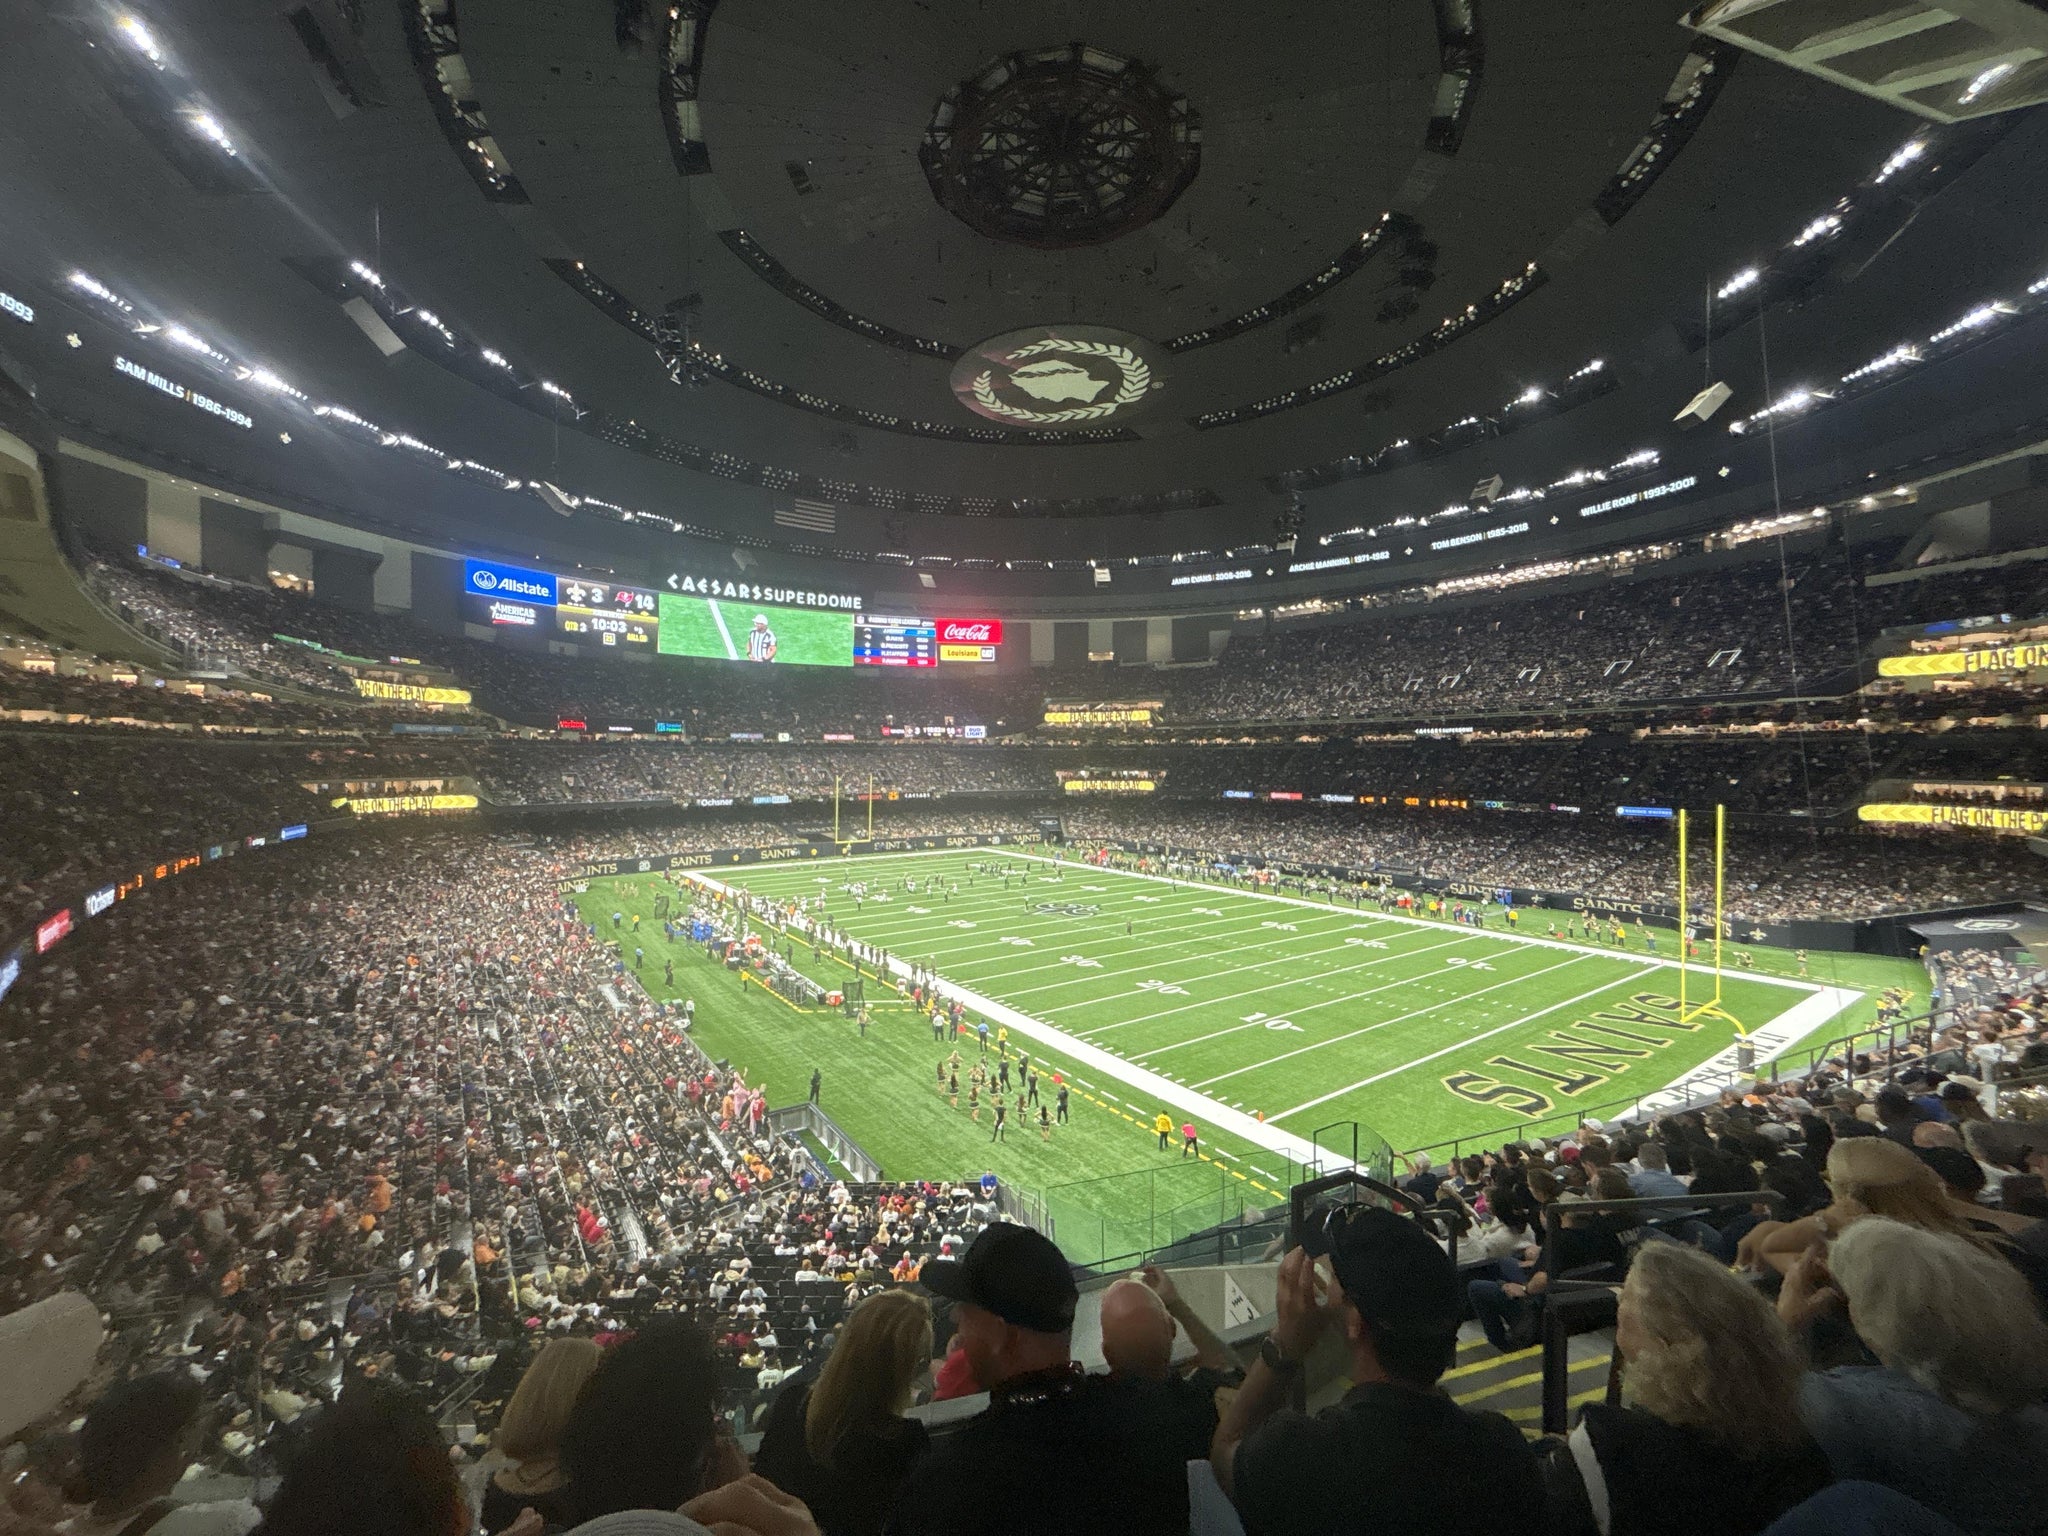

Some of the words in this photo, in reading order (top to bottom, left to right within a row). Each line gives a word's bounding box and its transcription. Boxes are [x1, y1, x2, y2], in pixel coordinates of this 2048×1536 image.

[115, 356, 146, 381] SAM
[147, 371, 185, 399] MILLS
[192, 392, 252, 428] 1986-1994
[1580, 500, 1611, 516] WILLIE
[1612, 493, 1638, 509] ROAF
[1643, 476, 1696, 499] 1993-2001
[1431, 538, 1450, 550] TOM
[1450, 532, 1482, 547] BENSON
[1487, 522, 1529, 539] 1985-2018
[1316, 557, 1350, 569] MANNING
[498, 577, 551, 598] Allstate
[667, 573, 762, 600] CAESARS
[764, 587, 862, 610] SUPERDOME
[592, 587, 604, 603] 3
[635, 594, 654, 611] 14
[592, 617, 628, 633] 10:03
[944, 624, 992, 641] Coca-Cola
[947, 649, 978, 657] Louisiana
[1964, 650, 2015, 671] FLAG
[372, 681, 385, 697] ON
[387, 685, 403, 699] THE
[405, 686, 427, 701] PLAY
[371, 799, 384, 812] ON
[388, 798, 405, 811] THE
[409, 796, 434, 810] PLAY
[701, 798, 733, 807] Ochsner
[1931, 807, 1969, 824] FLAG
[1974, 809, 1994, 826] ON
[2000, 811, 2025, 828] THE
[671, 854, 712, 868] SAINTS
[1573, 897, 1643, 914] SAINTS
[1136, 979, 1184, 995] 20
[1239, 1011, 1293, 1031] 10
[1440, 991, 1723, 1119] SAINTS
